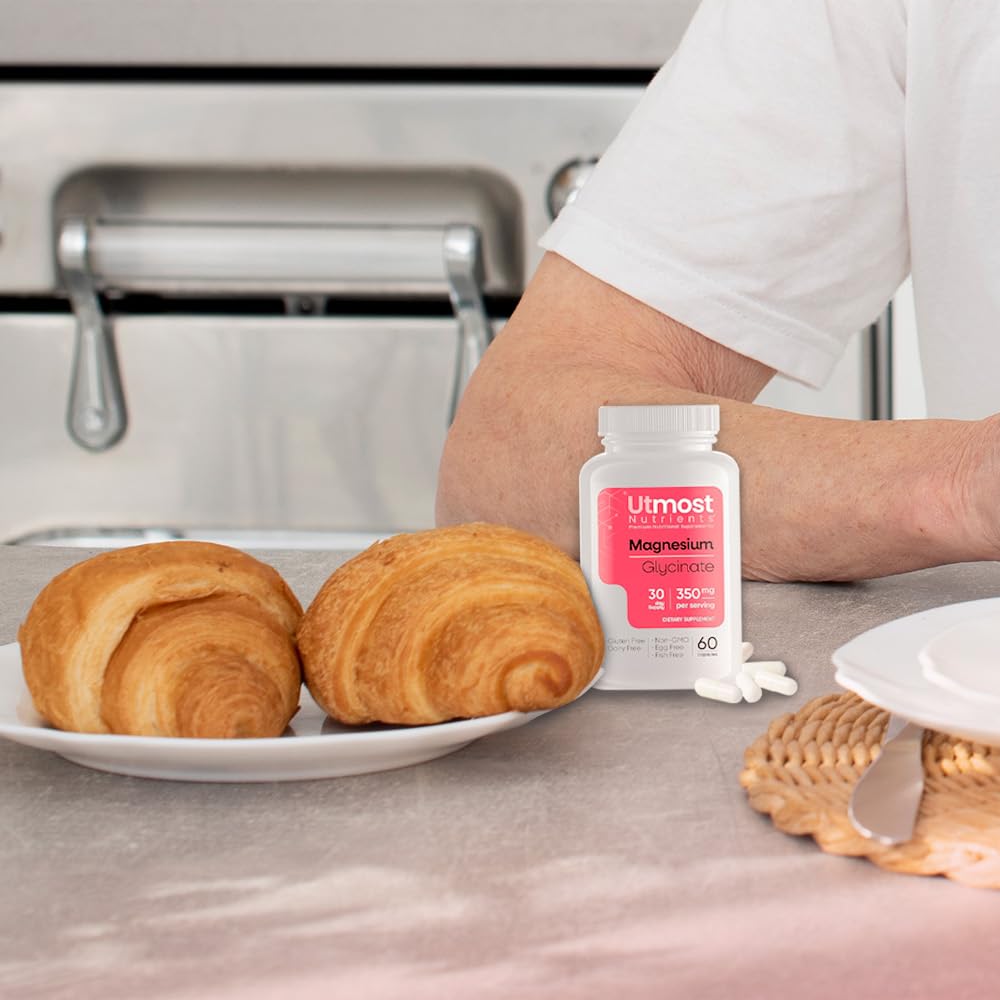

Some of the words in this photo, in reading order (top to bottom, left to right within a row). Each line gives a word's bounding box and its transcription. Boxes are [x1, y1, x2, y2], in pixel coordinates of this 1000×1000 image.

[627, 495, 714, 514] Utmost
[628, 515, 714, 524] Nutrients
[629, 538, 714, 554] Magnesium
[642, 560, 715, 576] Glycinate
[648, 588, 665, 600] 30
[690, 601, 716, 611] serving
[697, 636, 718, 650] 60
